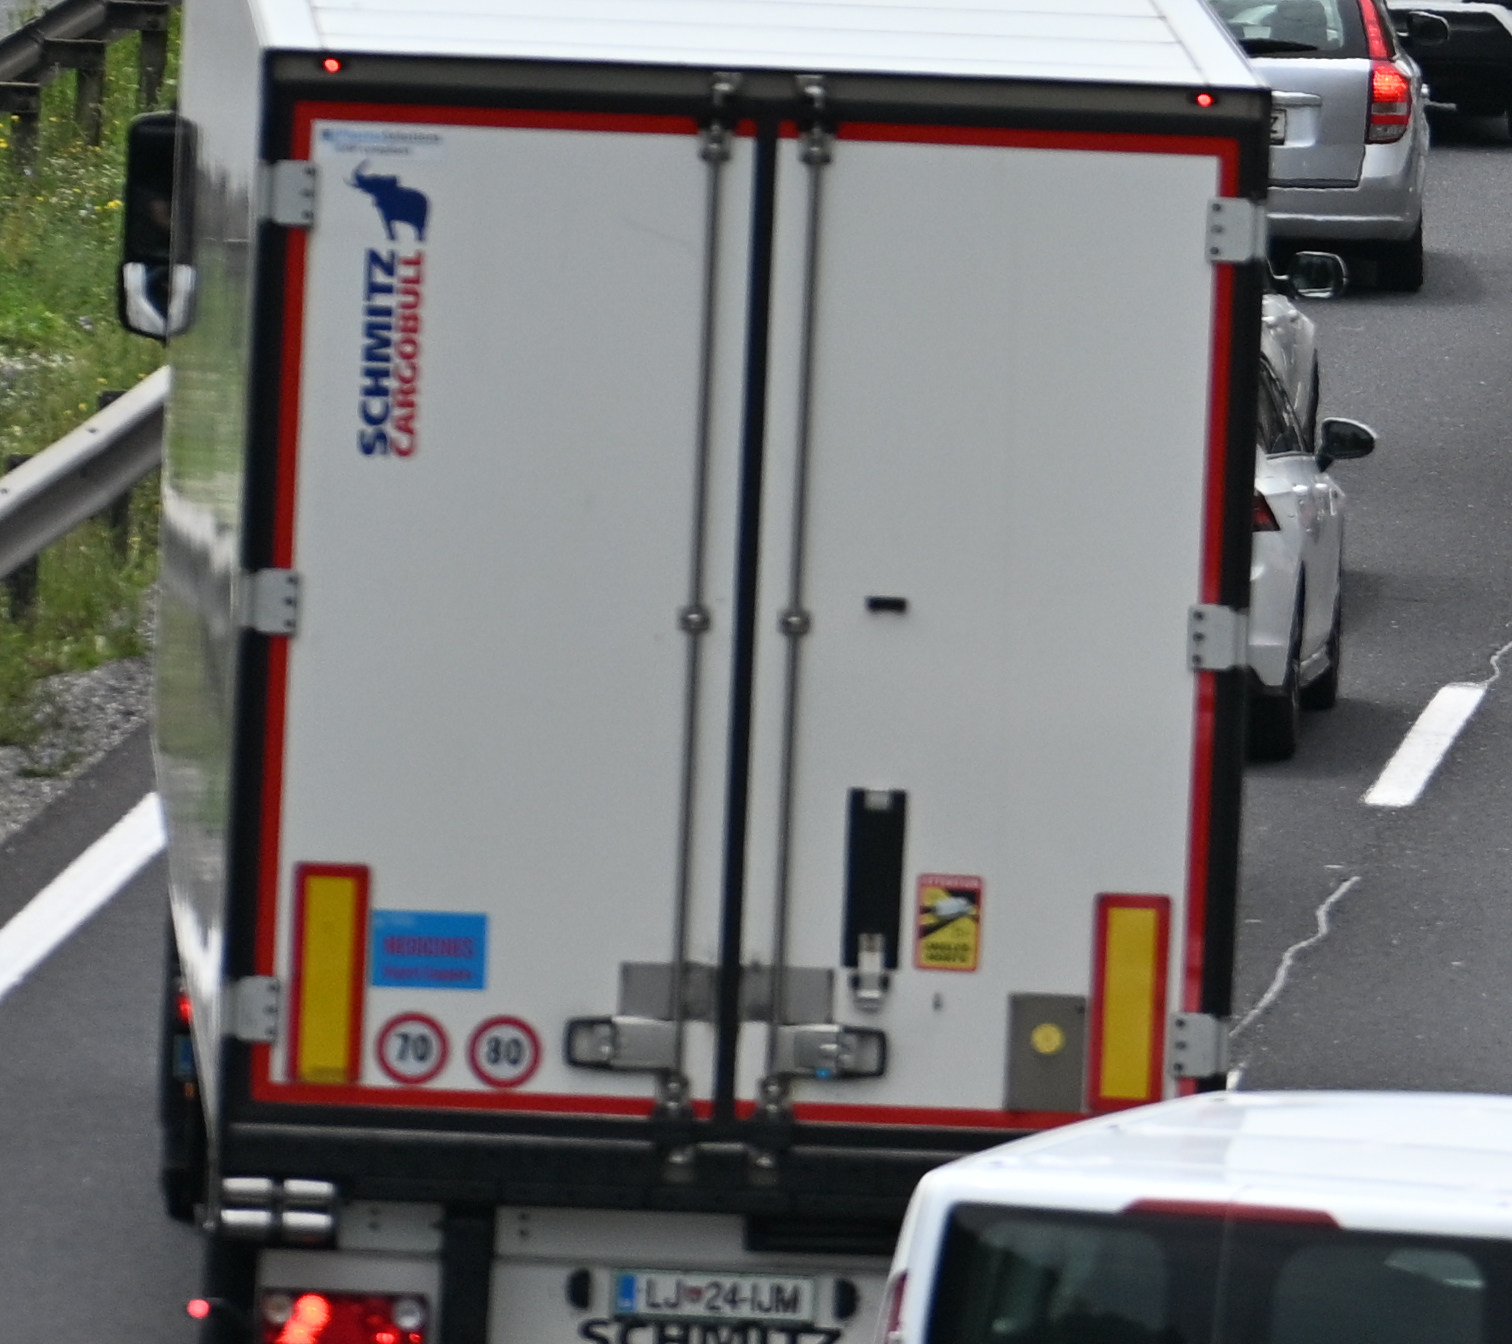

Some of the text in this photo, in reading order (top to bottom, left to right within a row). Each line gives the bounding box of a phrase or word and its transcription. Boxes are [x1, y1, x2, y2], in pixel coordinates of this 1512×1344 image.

[359, 247, 397, 458] SCHMITZ
[388, 249, 425, 459] CARGOBULL
[395, 1034, 432, 1062] 70
[486, 1035, 524, 1066] 80
[646, 1278, 685, 1309] LJ
